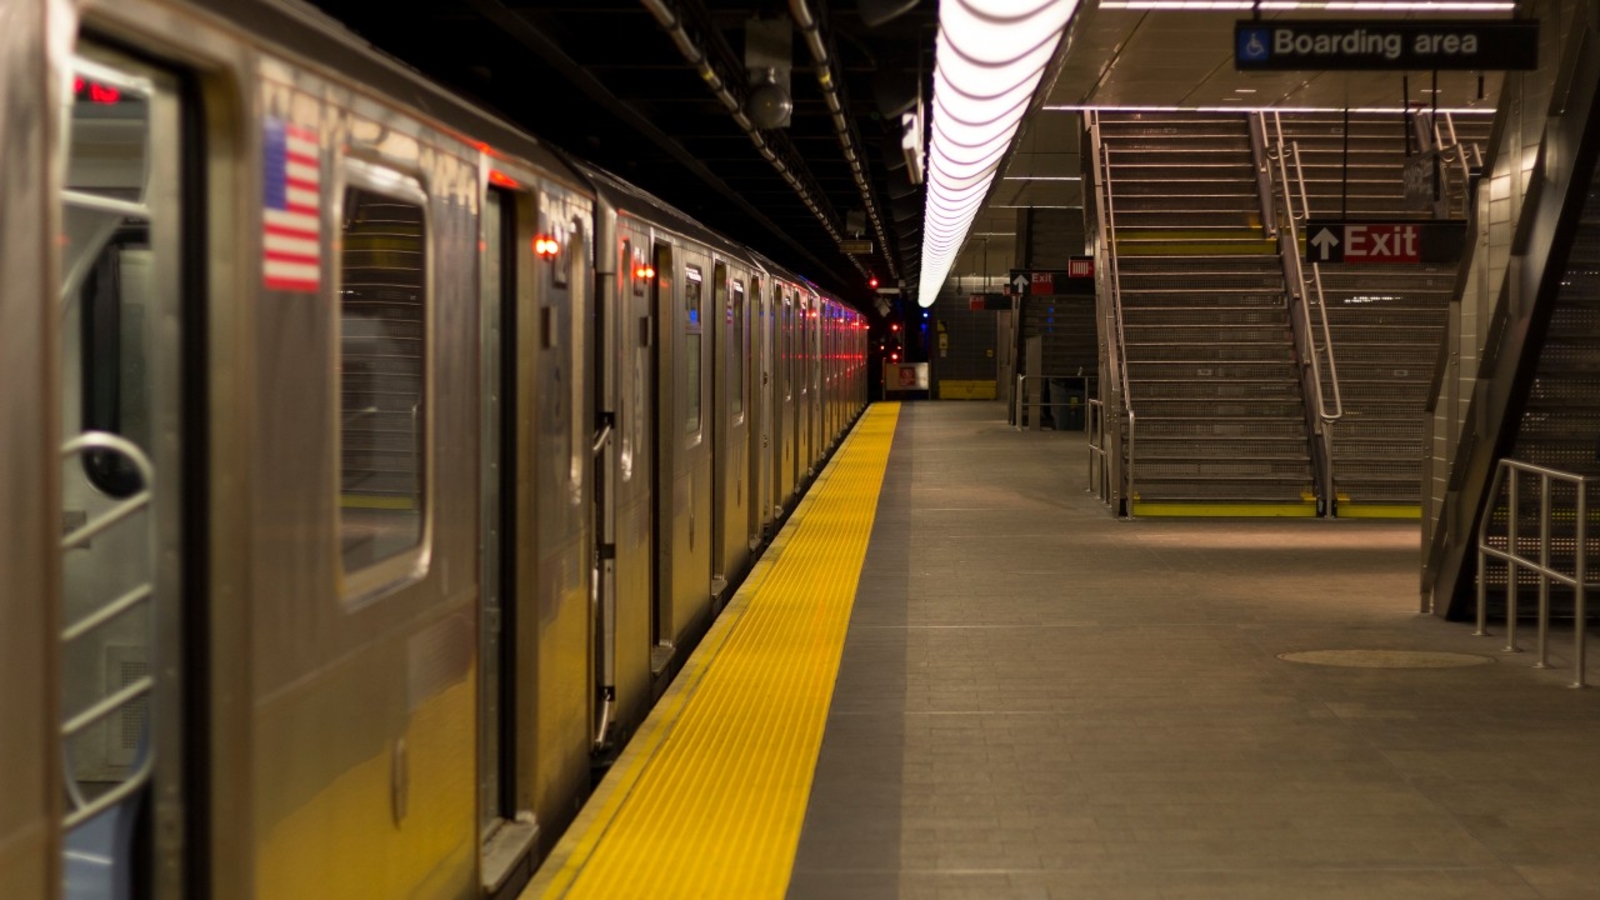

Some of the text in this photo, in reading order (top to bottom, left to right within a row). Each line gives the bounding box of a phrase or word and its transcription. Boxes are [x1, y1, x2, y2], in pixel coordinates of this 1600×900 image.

[1273, 29, 1478, 59] Boarding area
[1344, 226, 1417, 256] Exit
[1031, 273, 1052, 283] Exit
